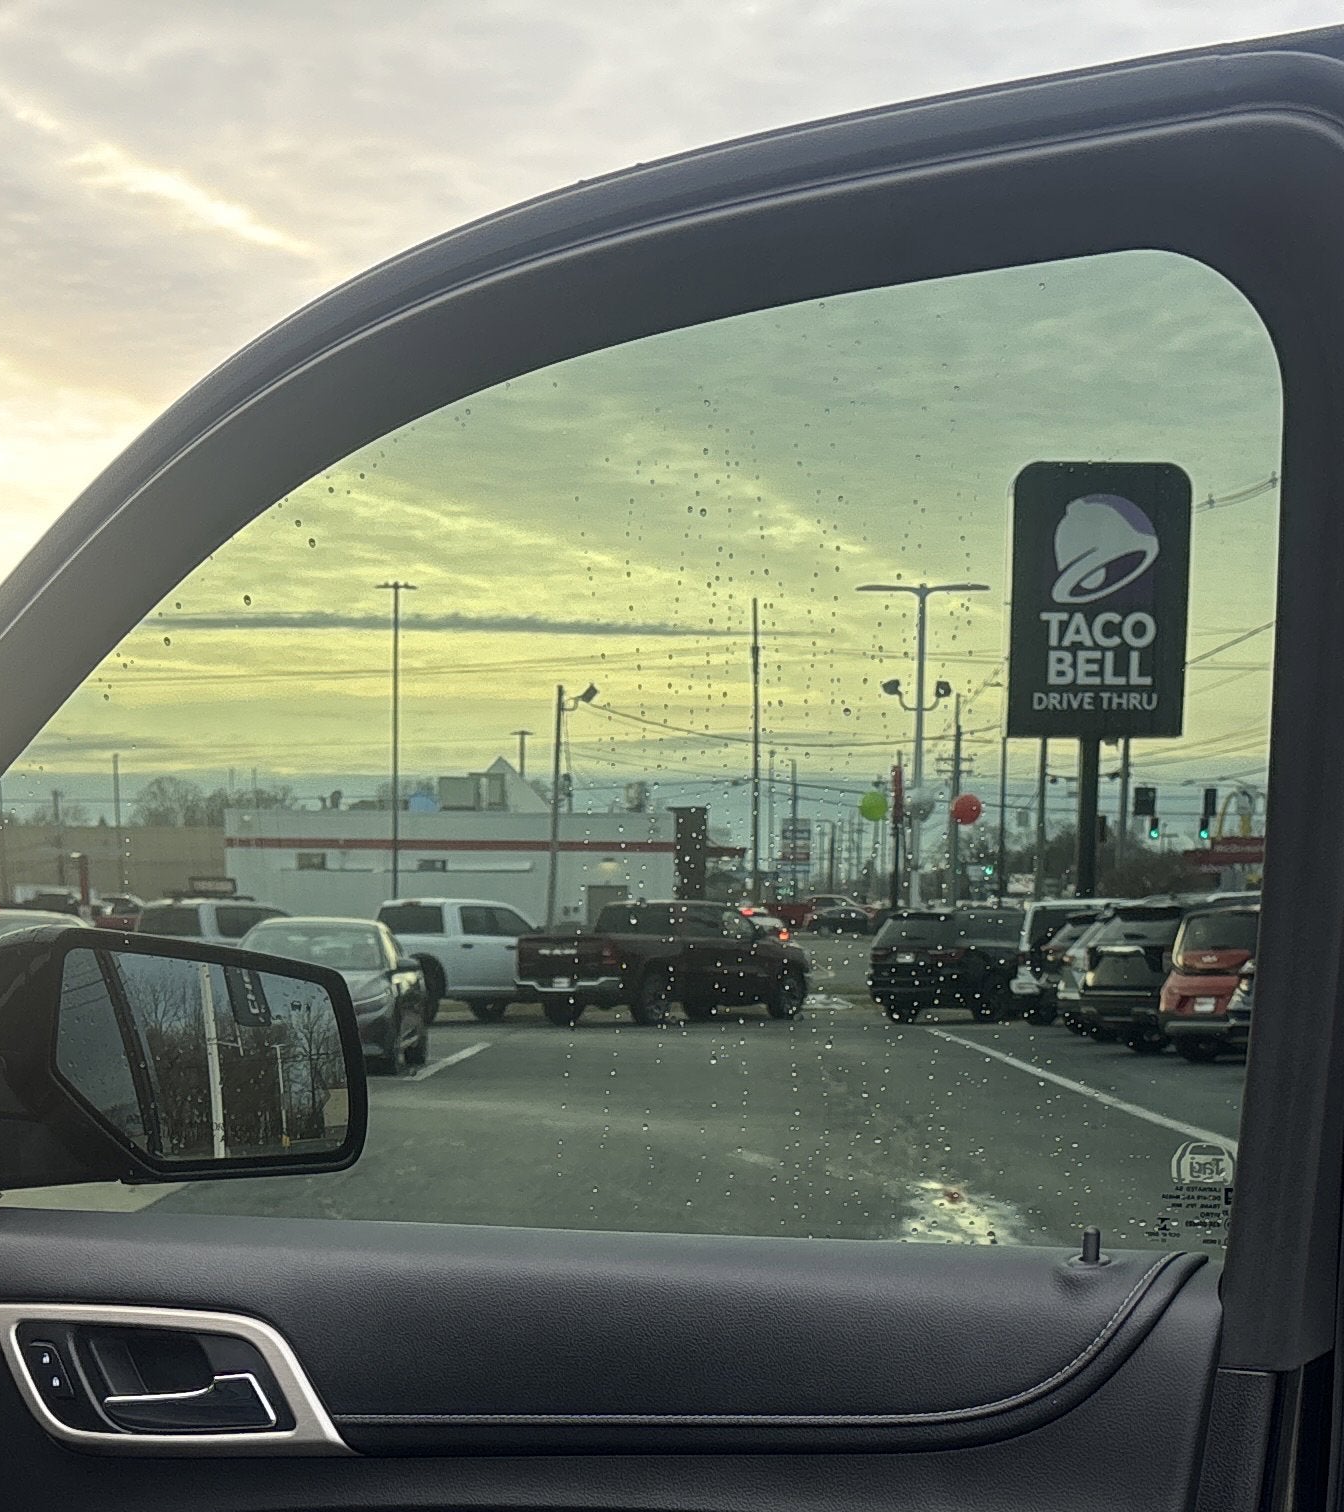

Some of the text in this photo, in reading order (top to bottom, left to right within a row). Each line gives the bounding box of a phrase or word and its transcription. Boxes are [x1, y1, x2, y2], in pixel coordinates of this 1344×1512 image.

[1040, 611, 1156, 648] TACO
[1047, 650, 1153, 685] BELL
[1032, 692, 1158, 711] DRIVE THRU
